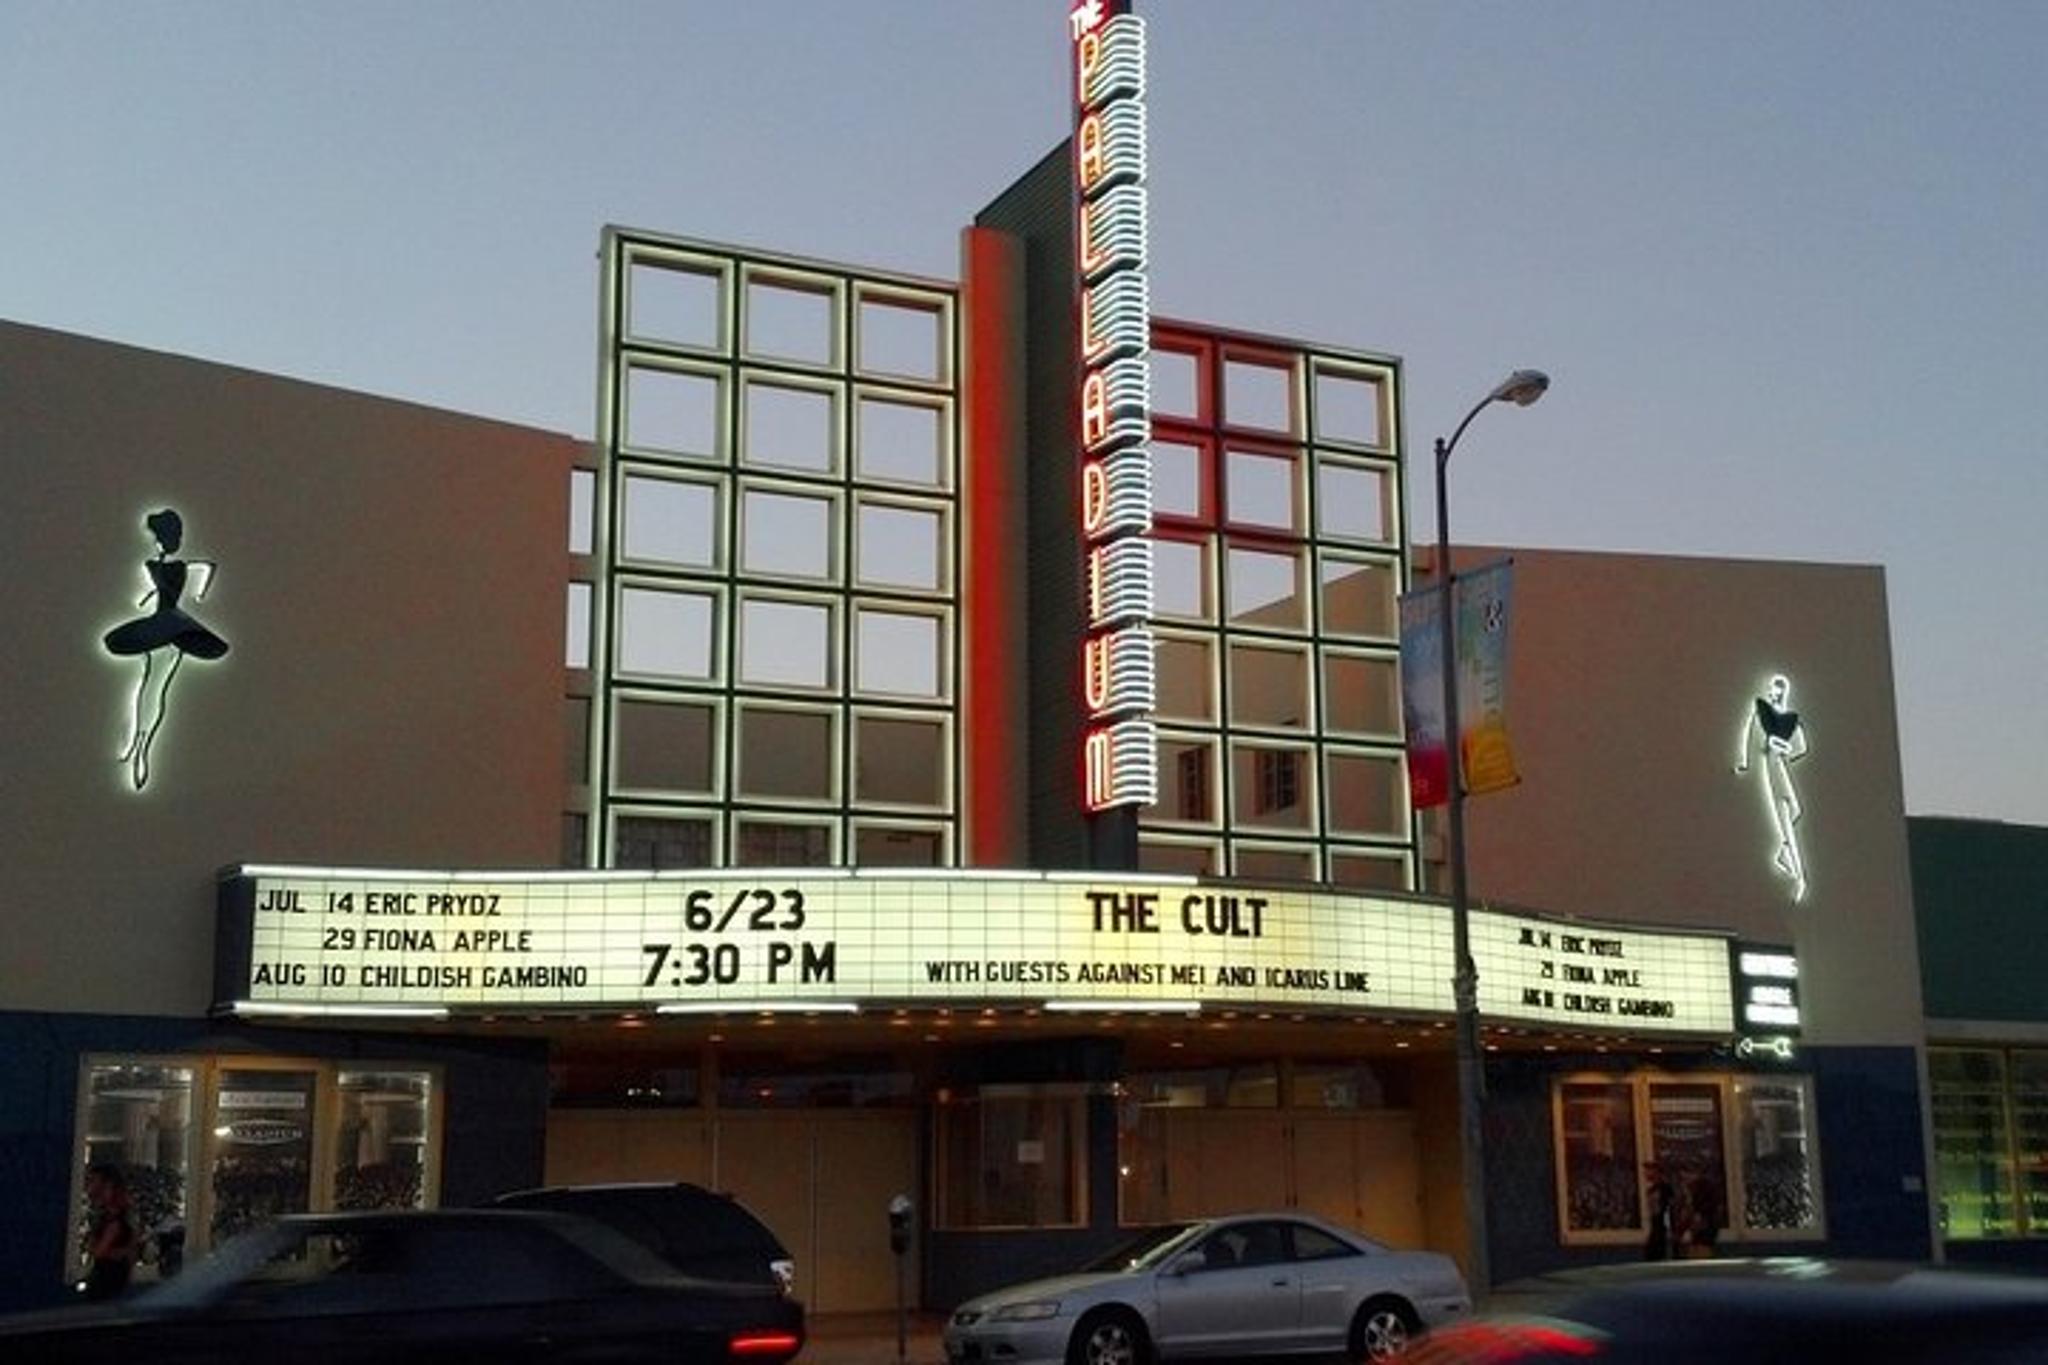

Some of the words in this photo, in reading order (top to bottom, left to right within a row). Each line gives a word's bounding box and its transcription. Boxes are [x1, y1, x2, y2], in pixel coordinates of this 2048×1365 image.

[260, 890, 306, 913] JUL
[328, 892, 354, 914] 14
[365, 892, 418, 916] ERIC
[426, 893, 501, 917] PRYDZ
[685, 889, 806, 933] 6/23
[1085, 892, 1160, 933] THE
[1181, 896, 1269, 937] CULT
[322, 927, 356, 951] 29
[363, 929, 436, 952] FIONA
[453, 930, 532, 953] APPLE
[252, 964, 307, 986] AUG
[322, 964, 346, 987] 10
[360, 965, 472, 988] CHILDISH
[482, 966, 587, 988] GAMBINO
[642, 943, 740, 987] 7:30
[767, 941, 836, 984] PM
[926, 961, 980, 983] WITH
[986, 961, 1070, 983] GUESTS
[1077, 963, 1164, 985] AGAINST
[1216, 966, 1257, 988] AND
[1265, 967, 1329, 991] ICARUS
[1334, 970, 1370, 993] LINE
